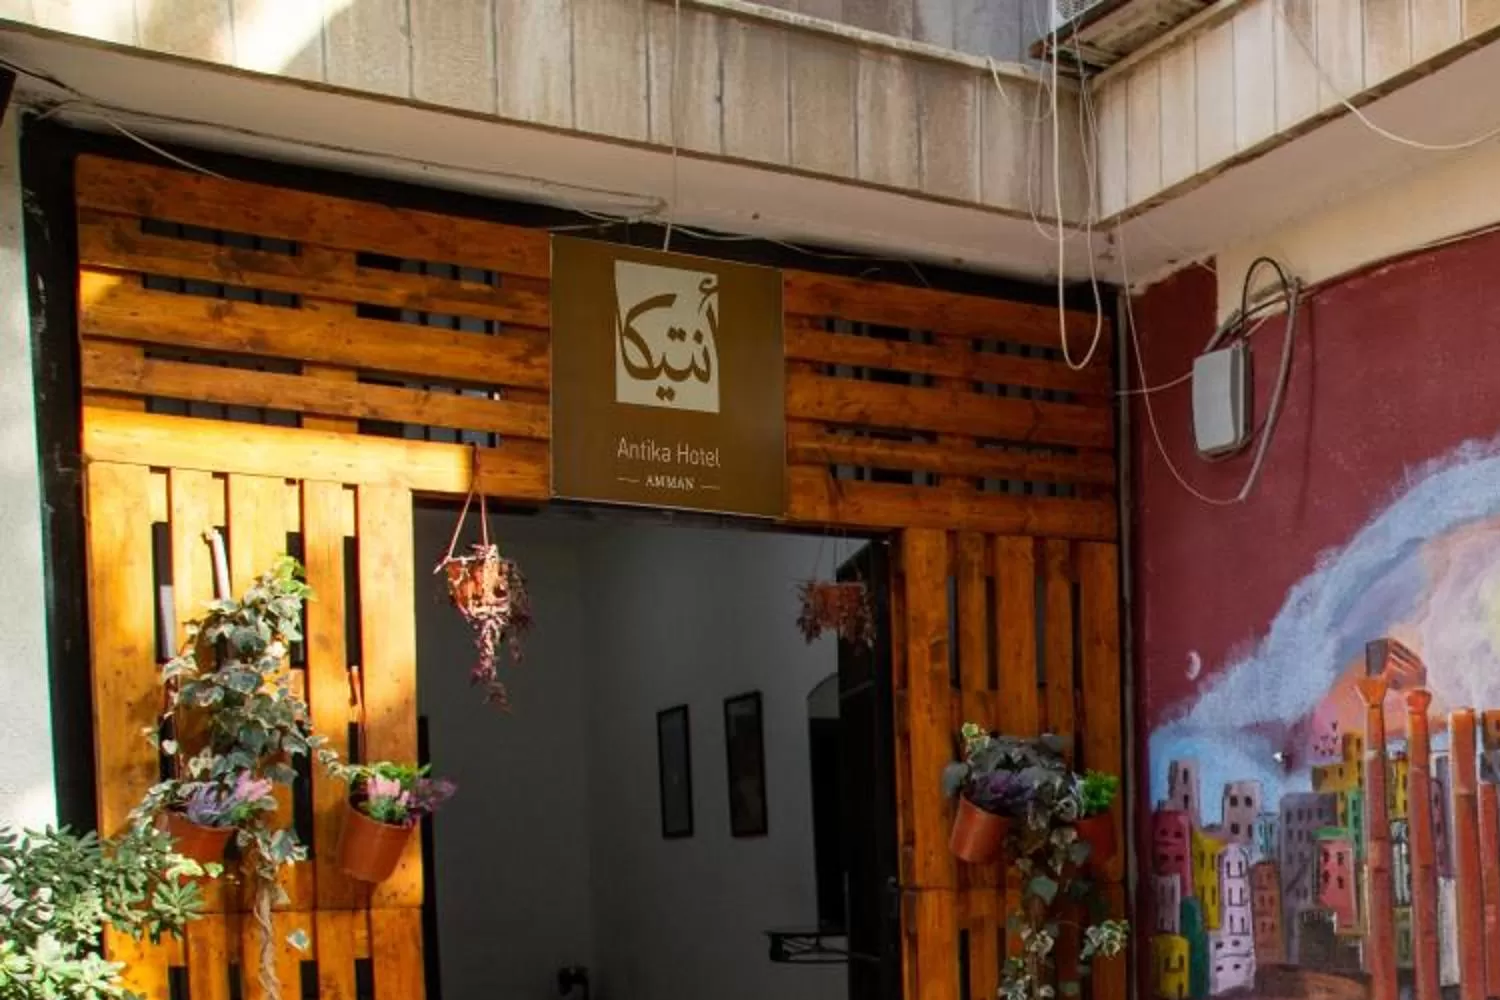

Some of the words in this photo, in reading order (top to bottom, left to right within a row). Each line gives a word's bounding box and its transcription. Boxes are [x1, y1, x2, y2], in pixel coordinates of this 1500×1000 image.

[617, 435, 671, 463] Antika
[676, 442, 720, 468] Hotel
[645, 474, 695, 491] AMMAN
